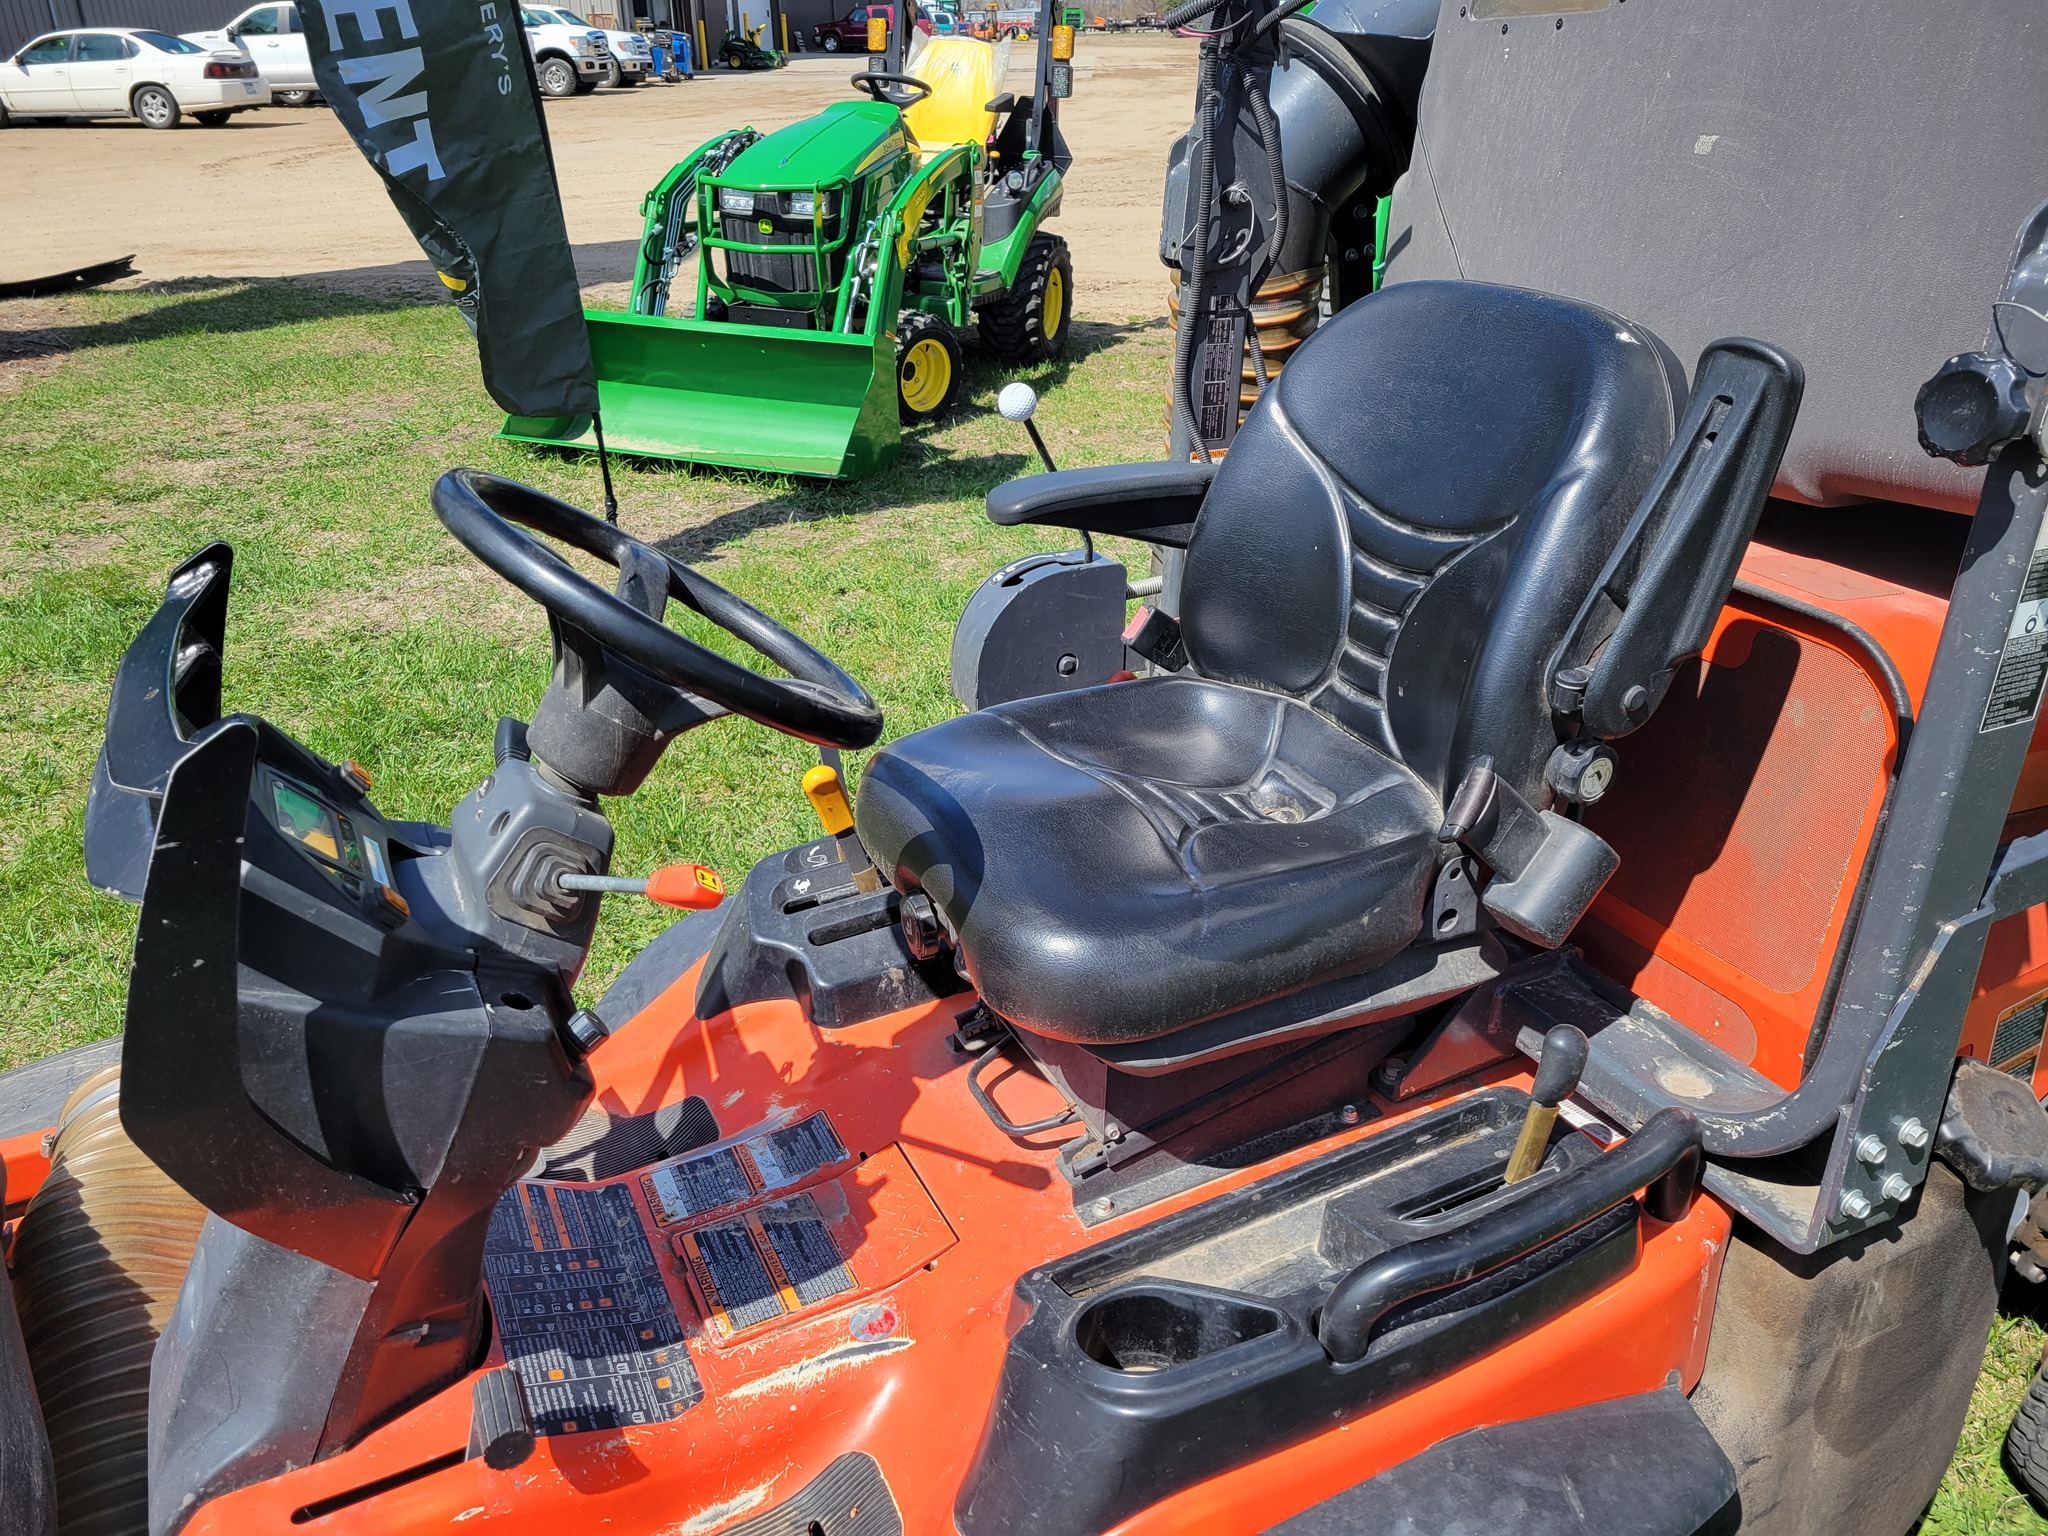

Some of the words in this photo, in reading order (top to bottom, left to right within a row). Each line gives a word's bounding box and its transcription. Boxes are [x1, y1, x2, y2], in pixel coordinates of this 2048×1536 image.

[737, 1142, 762, 1184] ADVERTENCIA
[641, 1177, 664, 1216] WARNING
[766, 1230, 781, 1252] LESIONES
[699, 1245, 711, 1262] INJURY
[777, 1252, 790, 1270] EVITAR
[690, 1255, 717, 1299] WARNING
[706, 1263, 722, 1288] PERSONAL
[786, 1269, 797, 1284] PARA
[717, 1288, 729, 1304] AVOID
